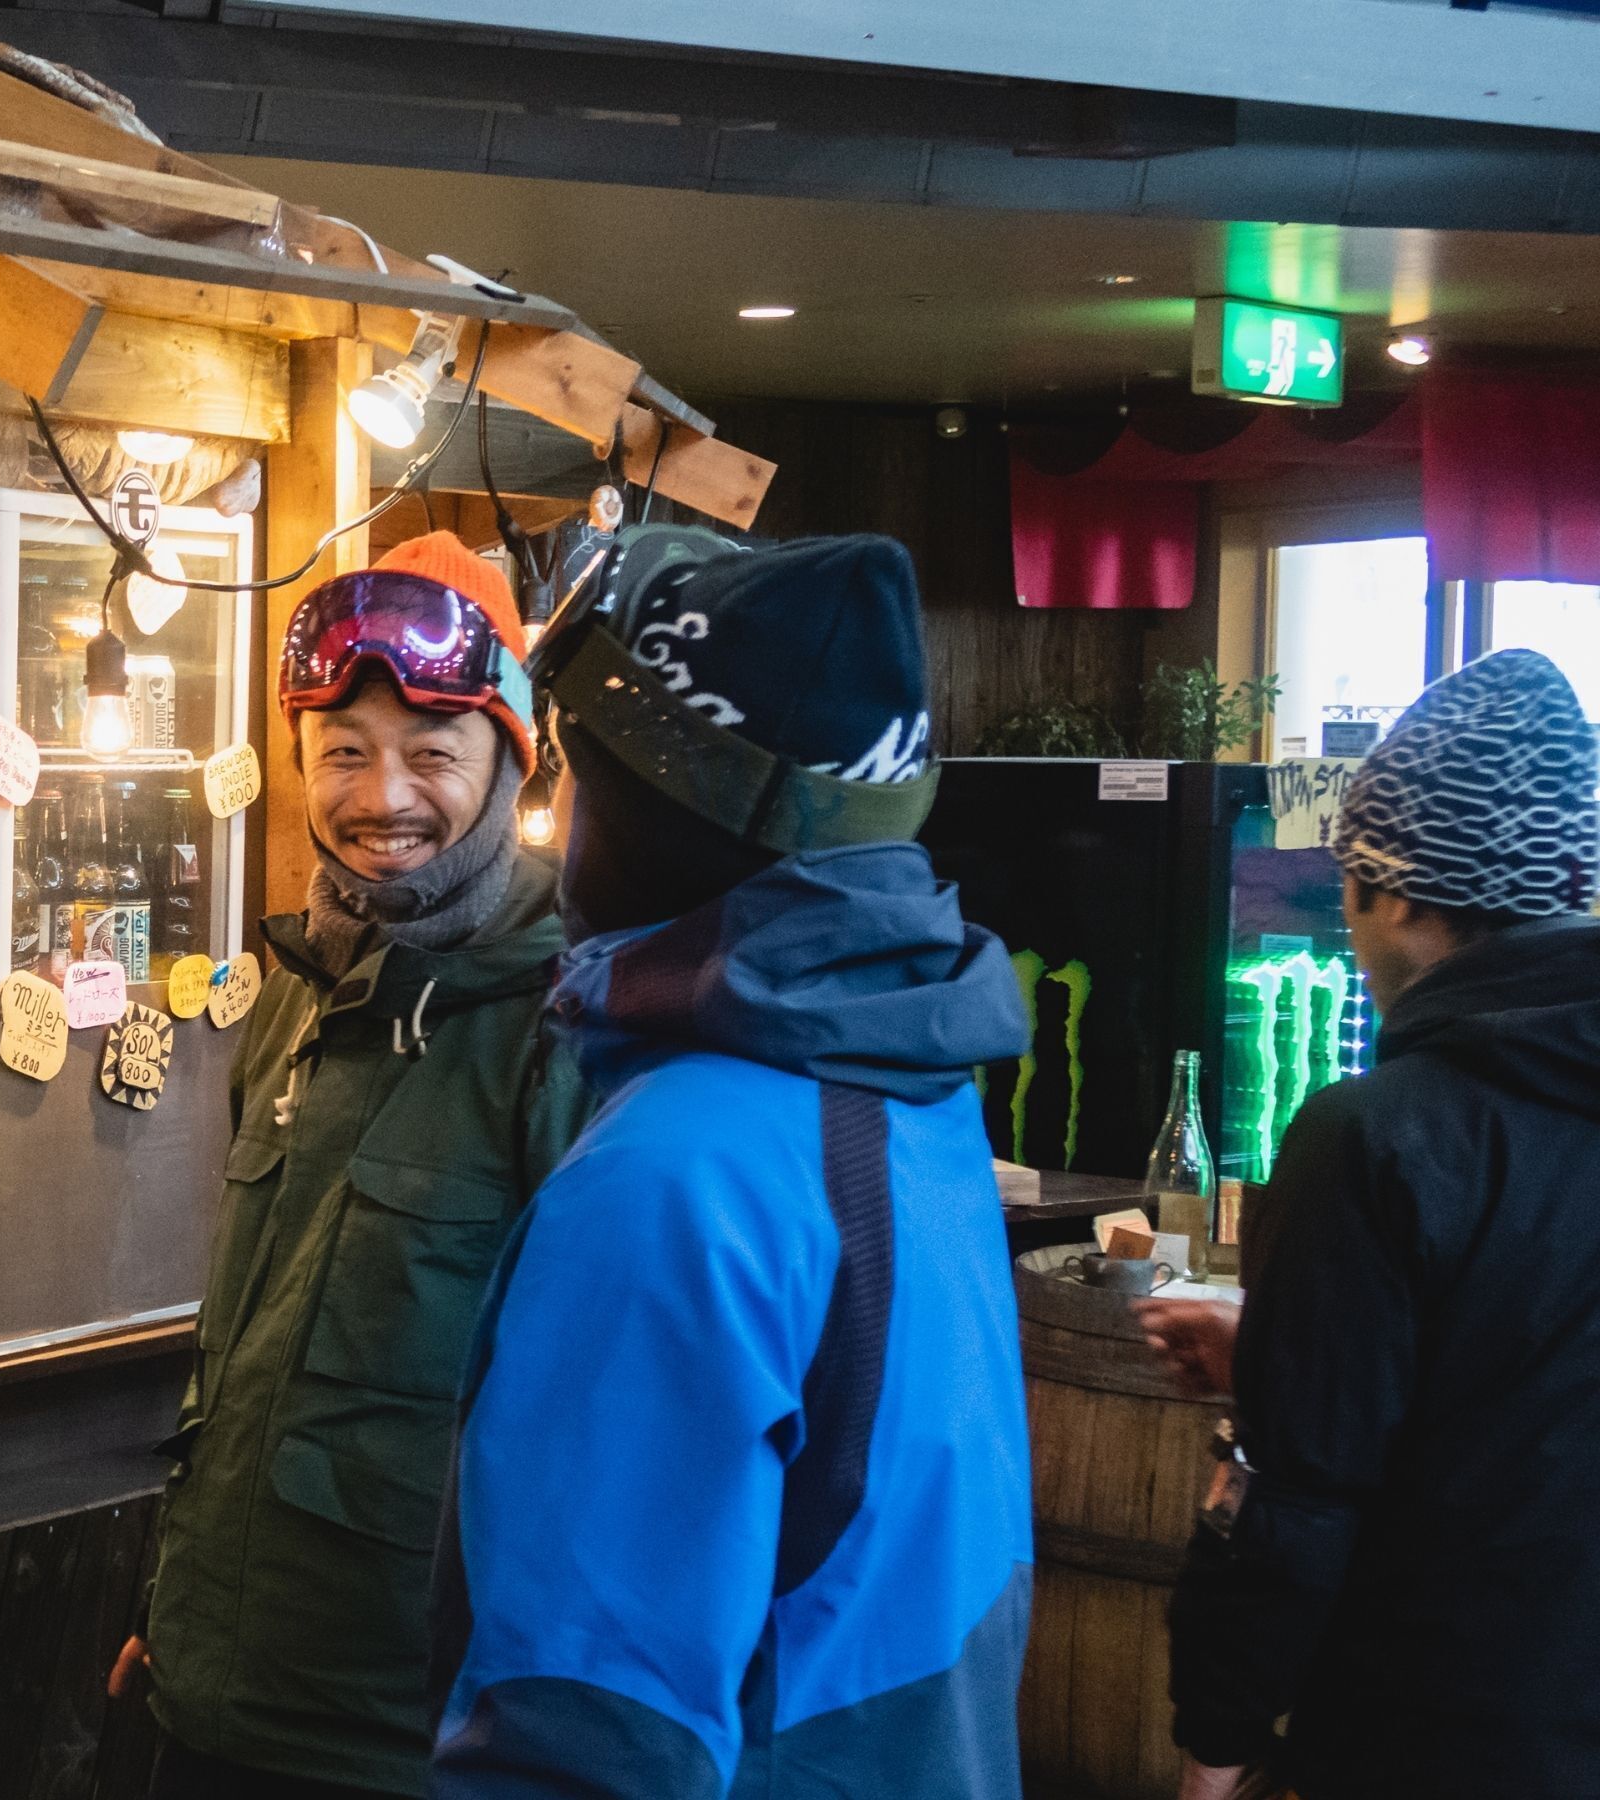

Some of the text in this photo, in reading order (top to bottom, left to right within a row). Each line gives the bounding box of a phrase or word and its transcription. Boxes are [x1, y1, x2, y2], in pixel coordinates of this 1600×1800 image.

[155, 702, 167, 748] REWDOG
[220, 764, 253, 790] INDIE
[220, 782, 254, 814] ¥800
[134, 909, 144, 981] PUNK IPA
[71, 968, 97, 980] New
[12, 982, 66, 1033] Miller
[220, 993, 250, 1024] ¥400
[126, 1027, 159, 1064] SOL
[11, 1049, 40, 1074] ¥800
[124, 1061, 151, 1083] 800
